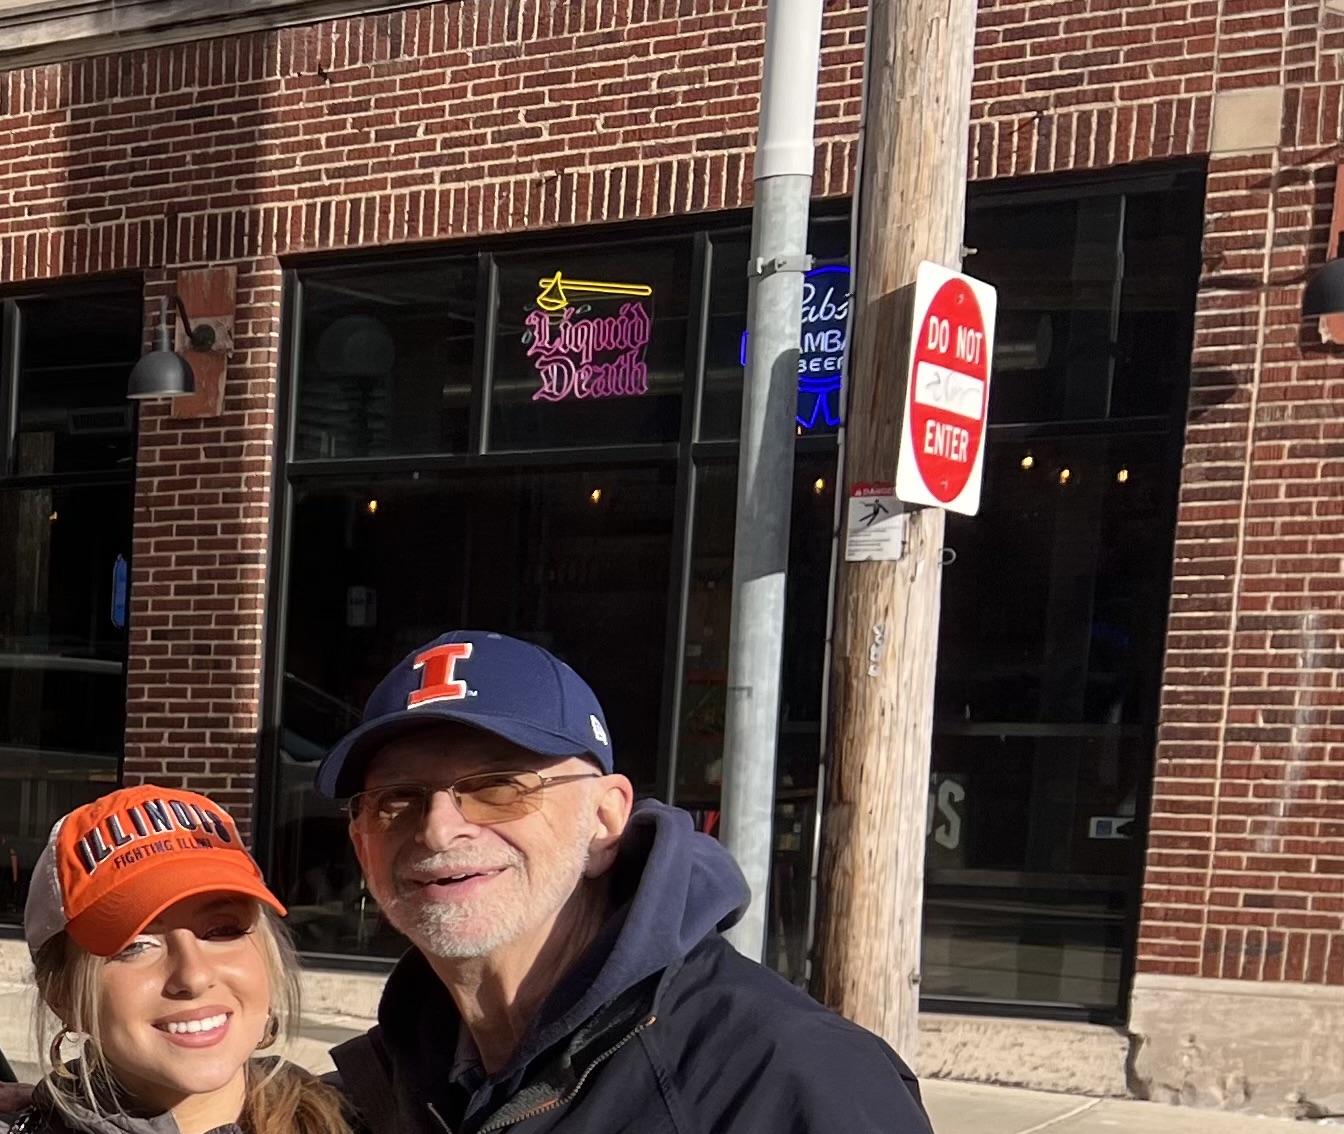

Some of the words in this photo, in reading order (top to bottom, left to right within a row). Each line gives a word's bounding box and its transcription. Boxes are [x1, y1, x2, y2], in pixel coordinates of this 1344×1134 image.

[525, 302, 651, 365] Liquid
[927, 315, 950, 354] DO
[956, 325, 983, 365] NOT
[532, 349, 649, 401] Death
[923, 419, 969, 463] ENTER
[407, 642, 473, 710] I
[76, 798, 231, 875] ILLINOIS
[113, 839, 175, 869] FIGHTING
